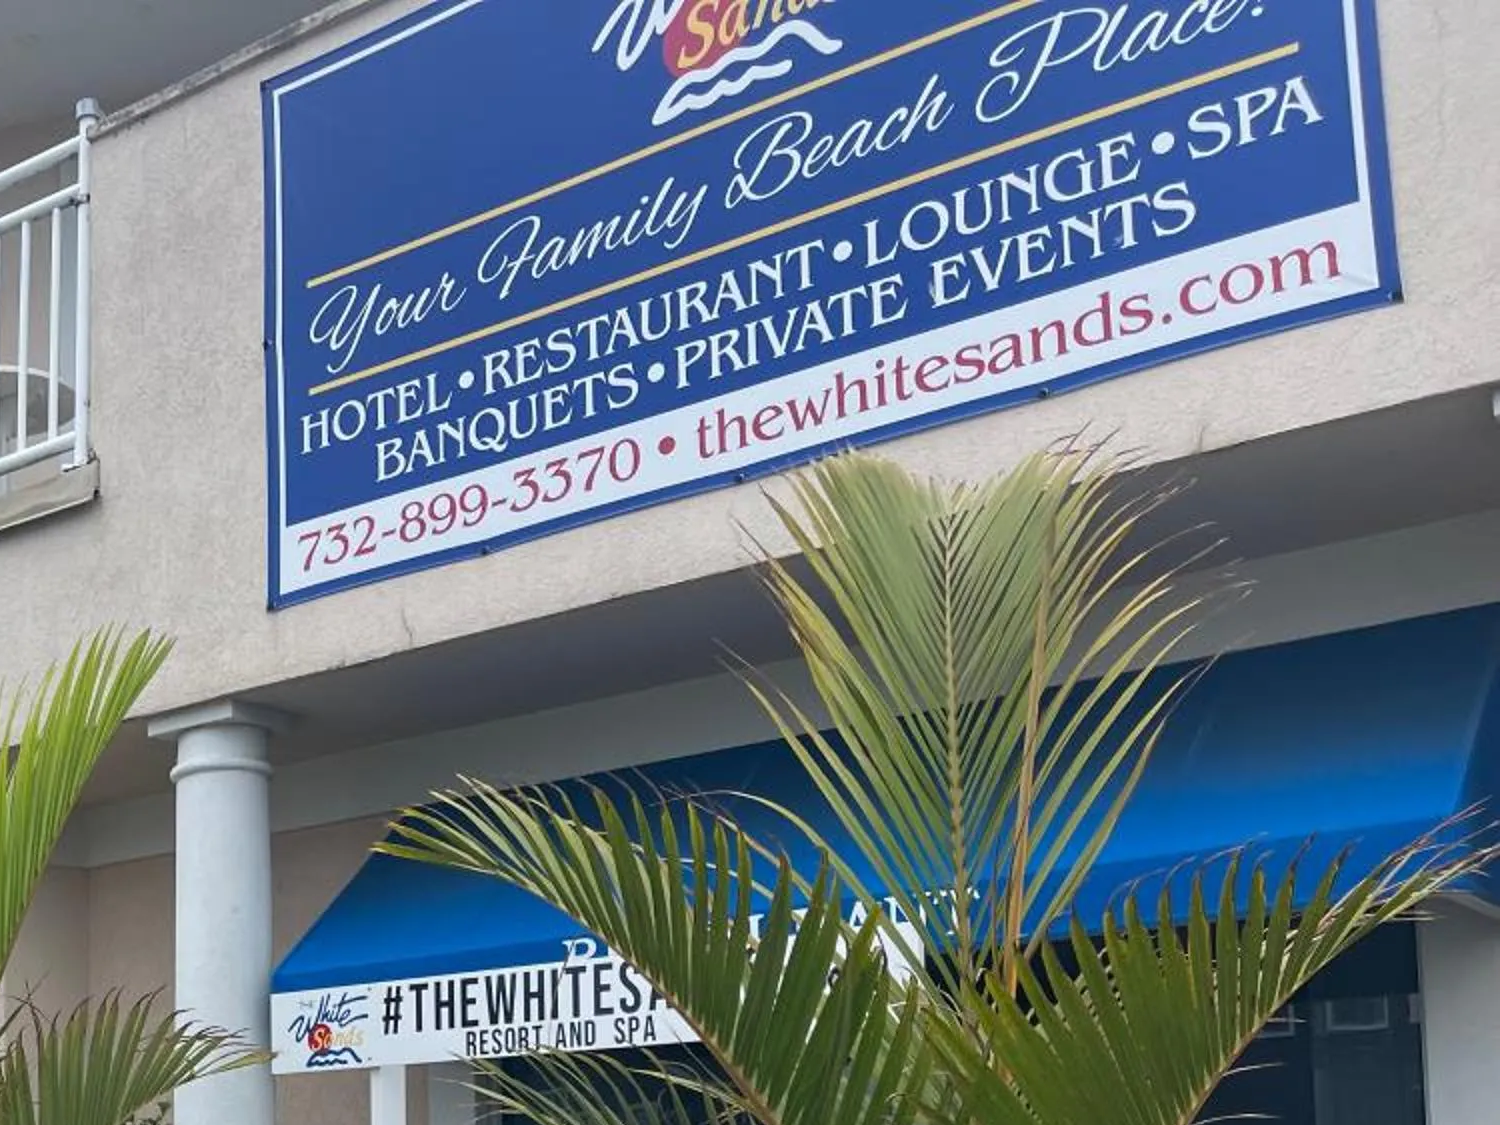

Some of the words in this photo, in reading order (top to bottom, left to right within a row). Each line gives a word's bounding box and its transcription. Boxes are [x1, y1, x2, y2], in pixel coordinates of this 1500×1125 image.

[300, 372, 453, 455] HOTEL
[482, 239, 826, 395] RESTAURANT
[864, 131, 1140, 269] LOUNGE
[1186, 75, 1325, 160] SPA
[309, 272, 468, 375] Your
[477, 176, 708, 299] Family
[725, 73, 955, 209] Beach
[376, 363, 640, 483] BANQUETS
[675, 274, 908, 390] PRIVATE
[929, 180, 1198, 309] EVENTS
[298, 438, 642, 573] 732-899-3370
[696, 238, 1341, 460] thewhitesands.com
[288, 992, 368, 1042] White
[466, 1025, 543, 1057] RESORT
[556, 1019, 596, 1049] AND
[614, 1015, 656, 1045] SPA
